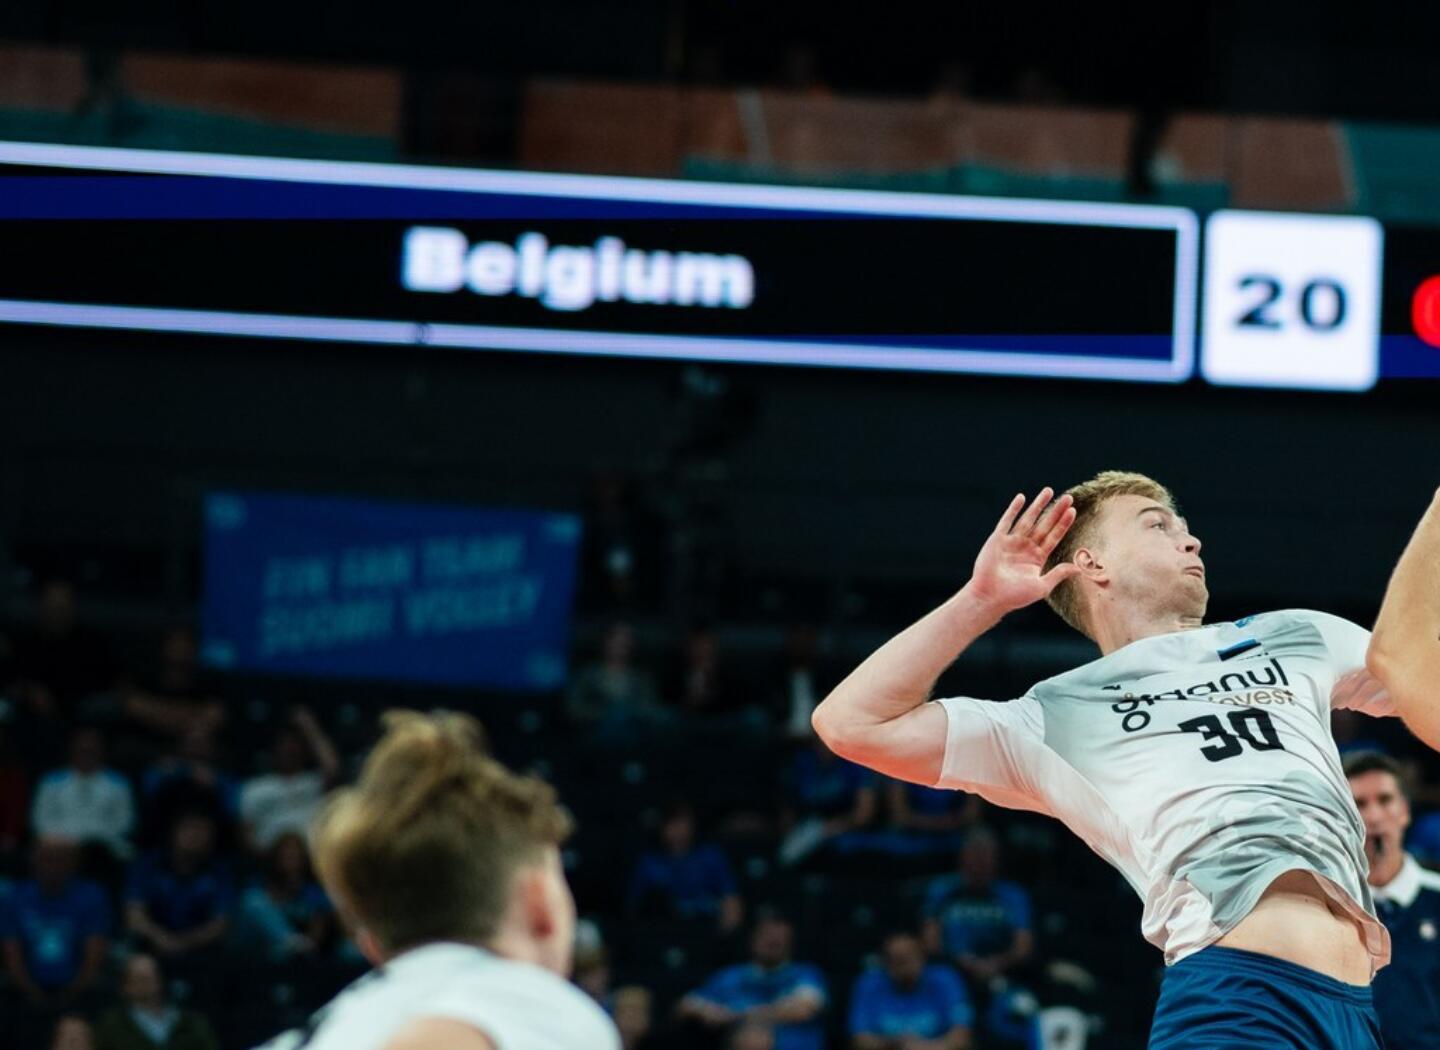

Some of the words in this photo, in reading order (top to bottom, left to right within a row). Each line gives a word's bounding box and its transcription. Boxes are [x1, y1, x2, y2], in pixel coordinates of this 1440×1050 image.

[402, 225, 754, 311] Belgium
[1235, 273, 1348, 332] 20
[1177, 707, 1286, 763] 30
